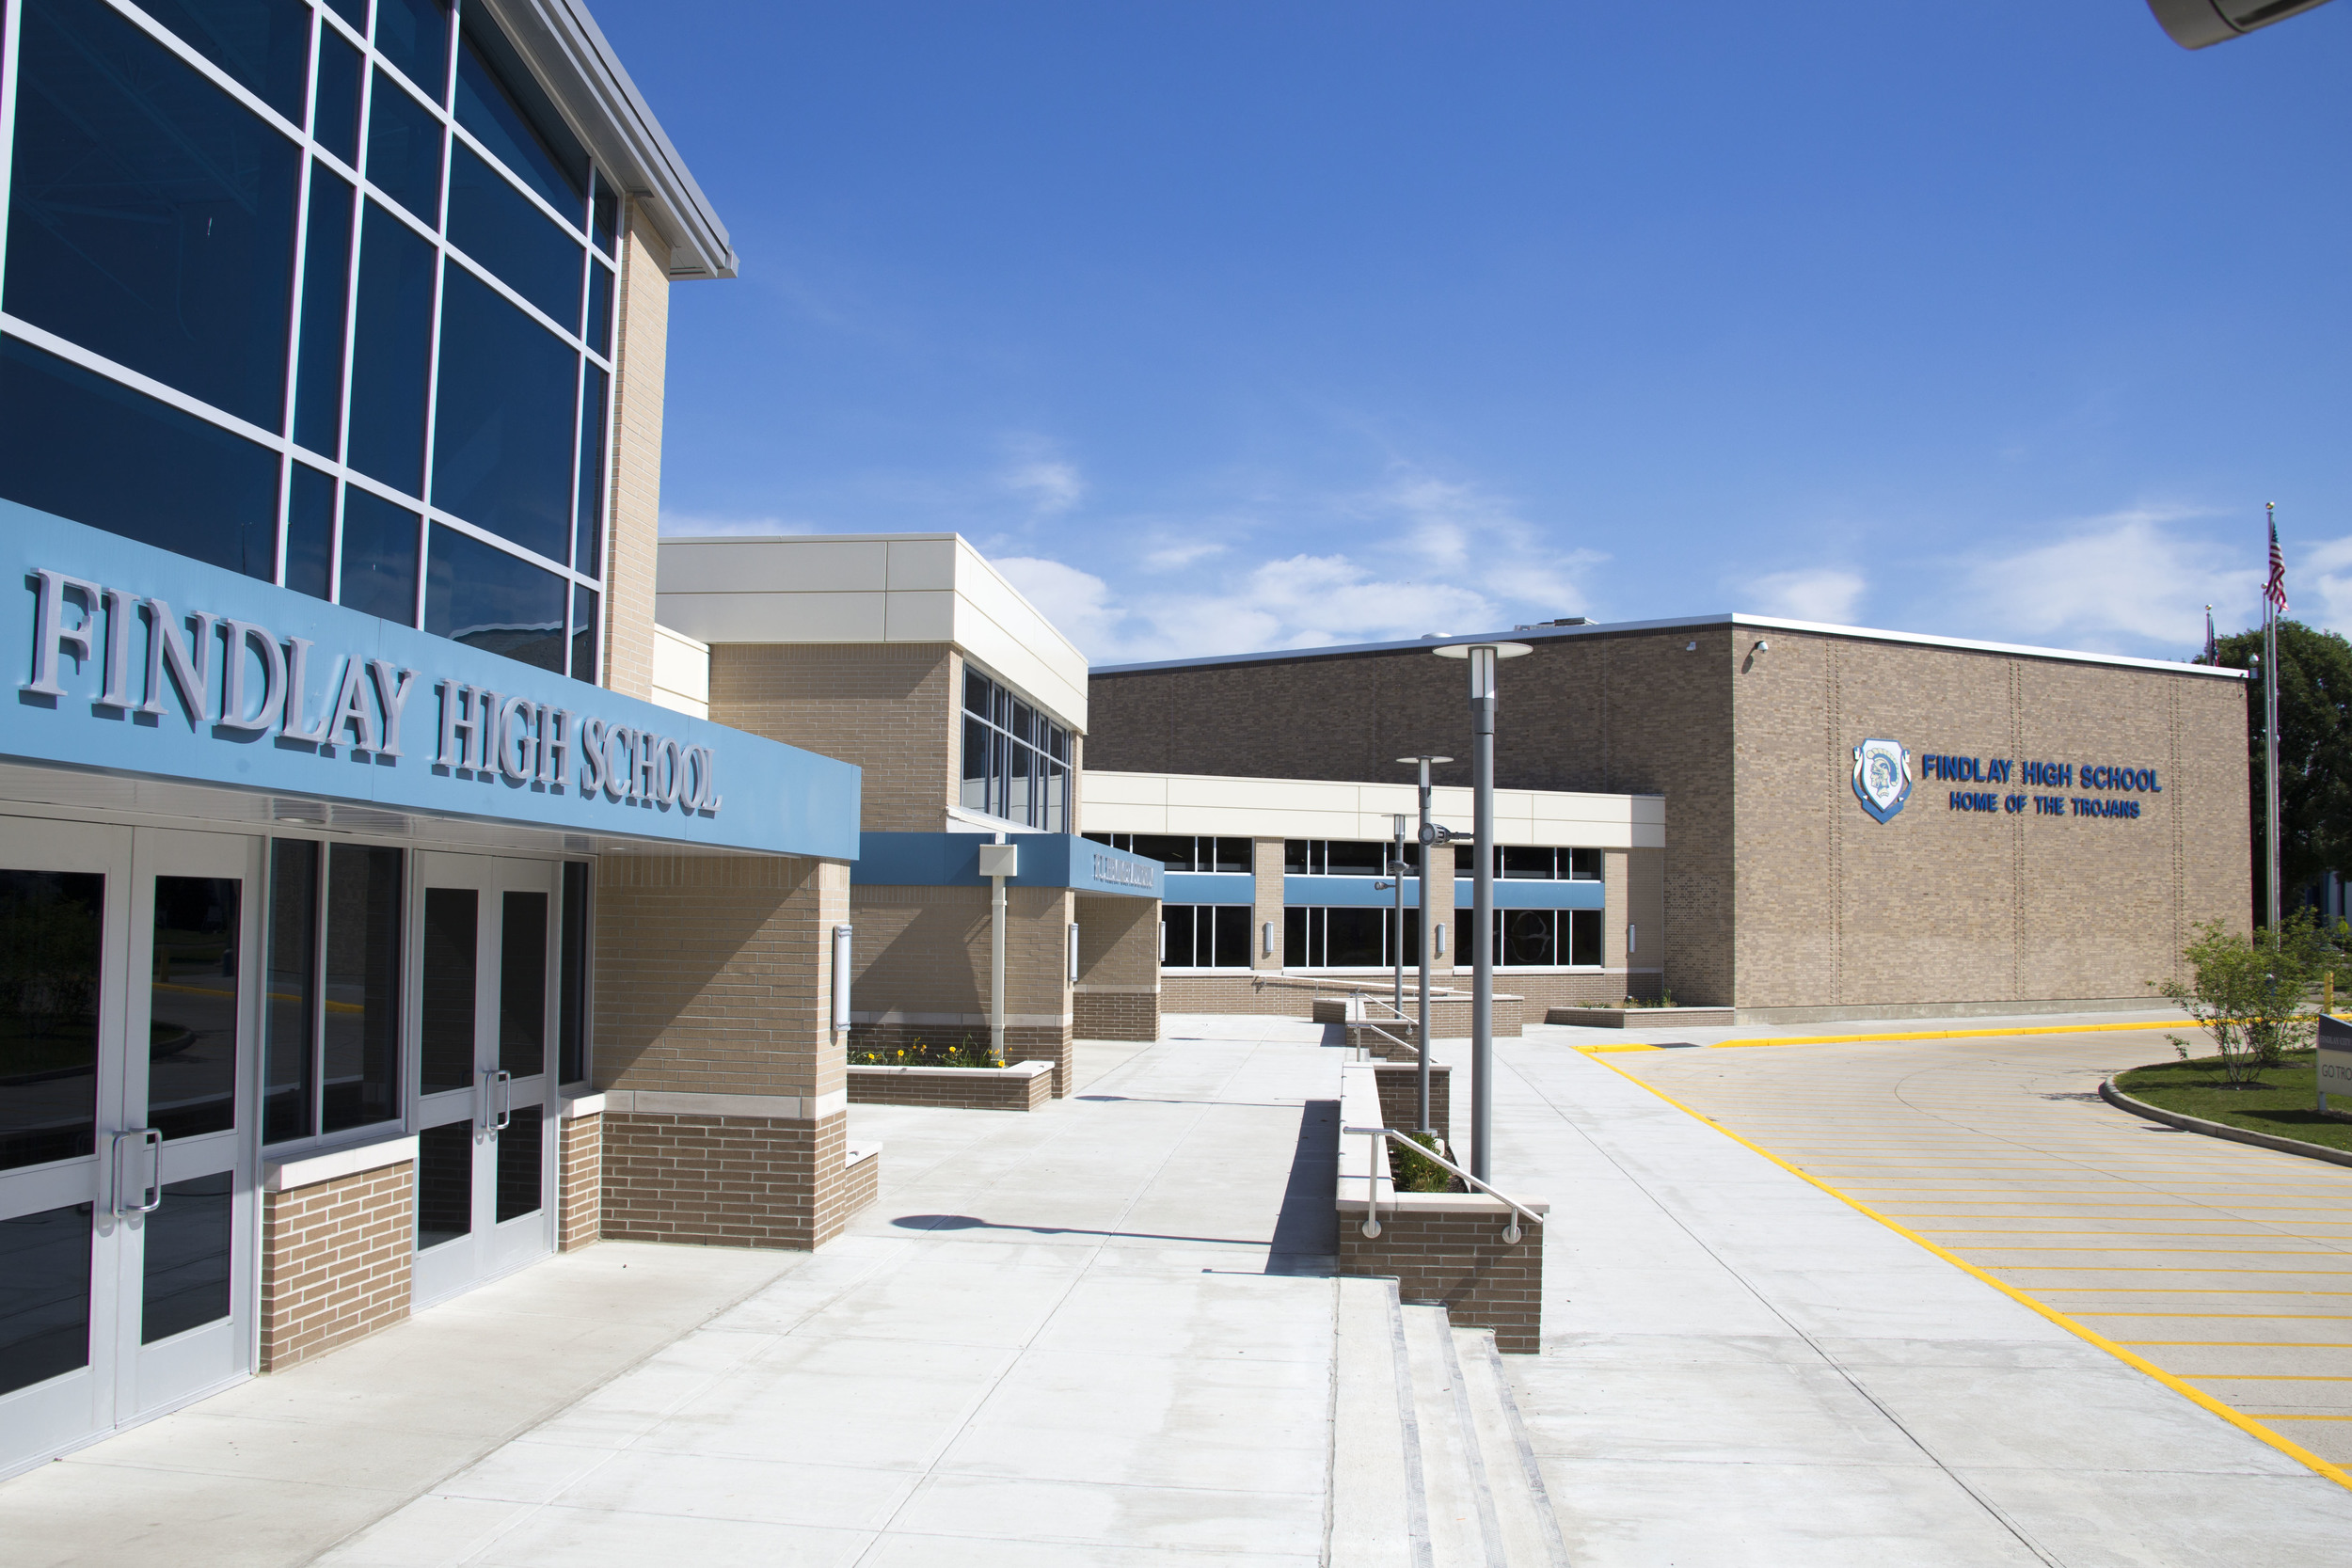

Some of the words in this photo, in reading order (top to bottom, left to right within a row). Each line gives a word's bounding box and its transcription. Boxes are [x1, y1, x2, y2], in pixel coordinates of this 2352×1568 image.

[21, 567, 422, 757] FINDLAY
[435, 677, 576, 785] HIGH
[581, 716, 723, 812] SCHOOL
[1922, 753, 2012, 783] FINDLAY
[2023, 761, 2073, 786] HIGH
[2080, 764, 2162, 791] SCHOOL
[1950, 791, 1998, 812] HOME
[2005, 794, 2027, 814] OF
[2034, 796, 2065, 815] THE
[2072, 798, 2140, 818] TROJANS
[2322, 1064, 2334, 1078] GO
